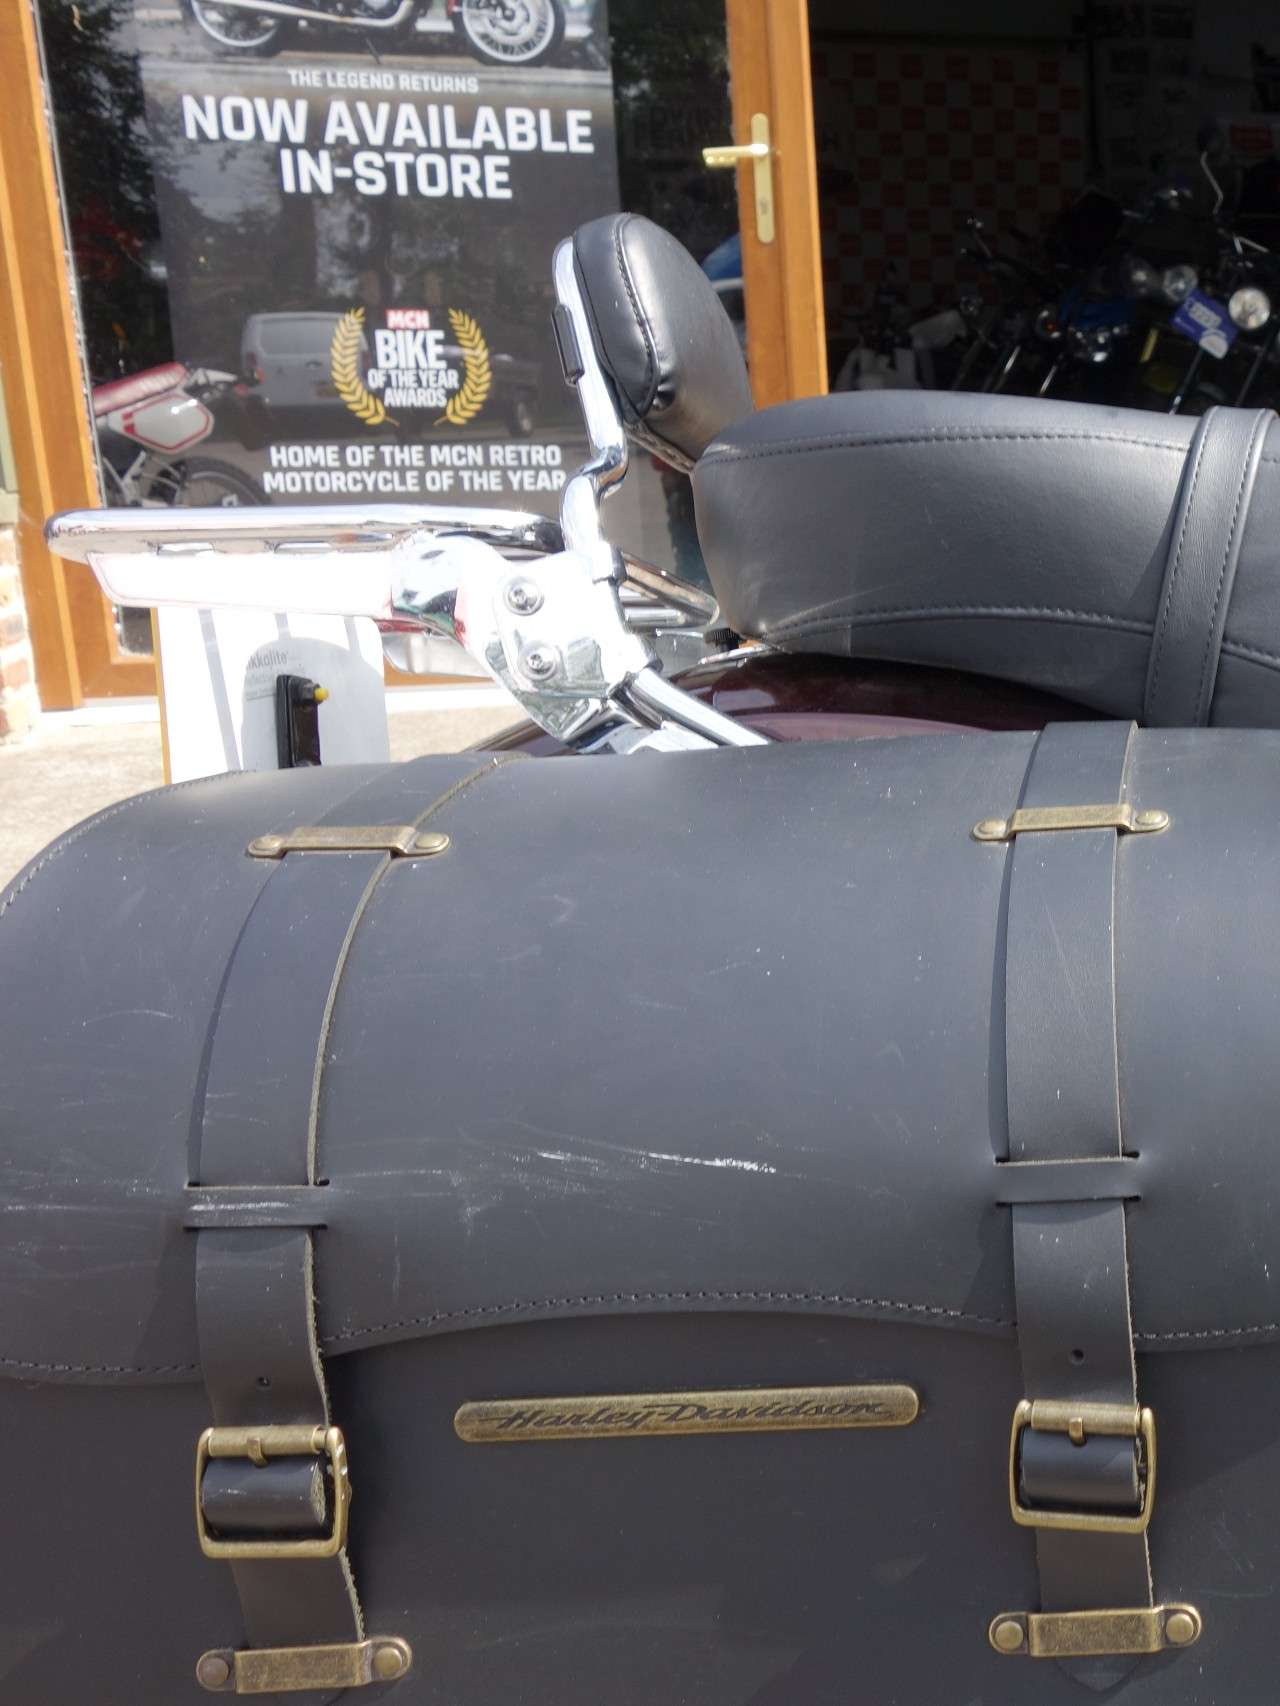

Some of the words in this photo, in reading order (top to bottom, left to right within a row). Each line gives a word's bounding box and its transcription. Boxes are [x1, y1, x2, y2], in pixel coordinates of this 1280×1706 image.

[288, 70, 323, 88] THE
[326, 71, 395, 90] LEGEND
[399, 73, 479, 94] RETURNS
[182, 94, 308, 143] NOW
[324, 101, 595, 154] AVAILABLE
[280, 148, 513, 200] IN-STORE
[387, 310, 430, 328] MCN
[374, 329, 448, 369] BIKE
[368, 370, 387, 388] OF
[390, 370, 418, 388] THE
[418, 369, 459, 389] YEAR
[384, 388, 448, 408] AWARDS
[269, 445, 341, 468] HOME
[345, 445, 376, 467] OF
[379, 445, 425, 467] THE
[430, 445, 484, 467] MCN
[489, 445, 562, 467] RETRO
[262, 470, 421, 494] MOTORCYCLE
[425, 470, 454, 492] OF
[459, 470, 503, 492] THE
[506, 470, 567, 492] YEAR
[481, 1400, 893, 1431] Harley-Davidson
